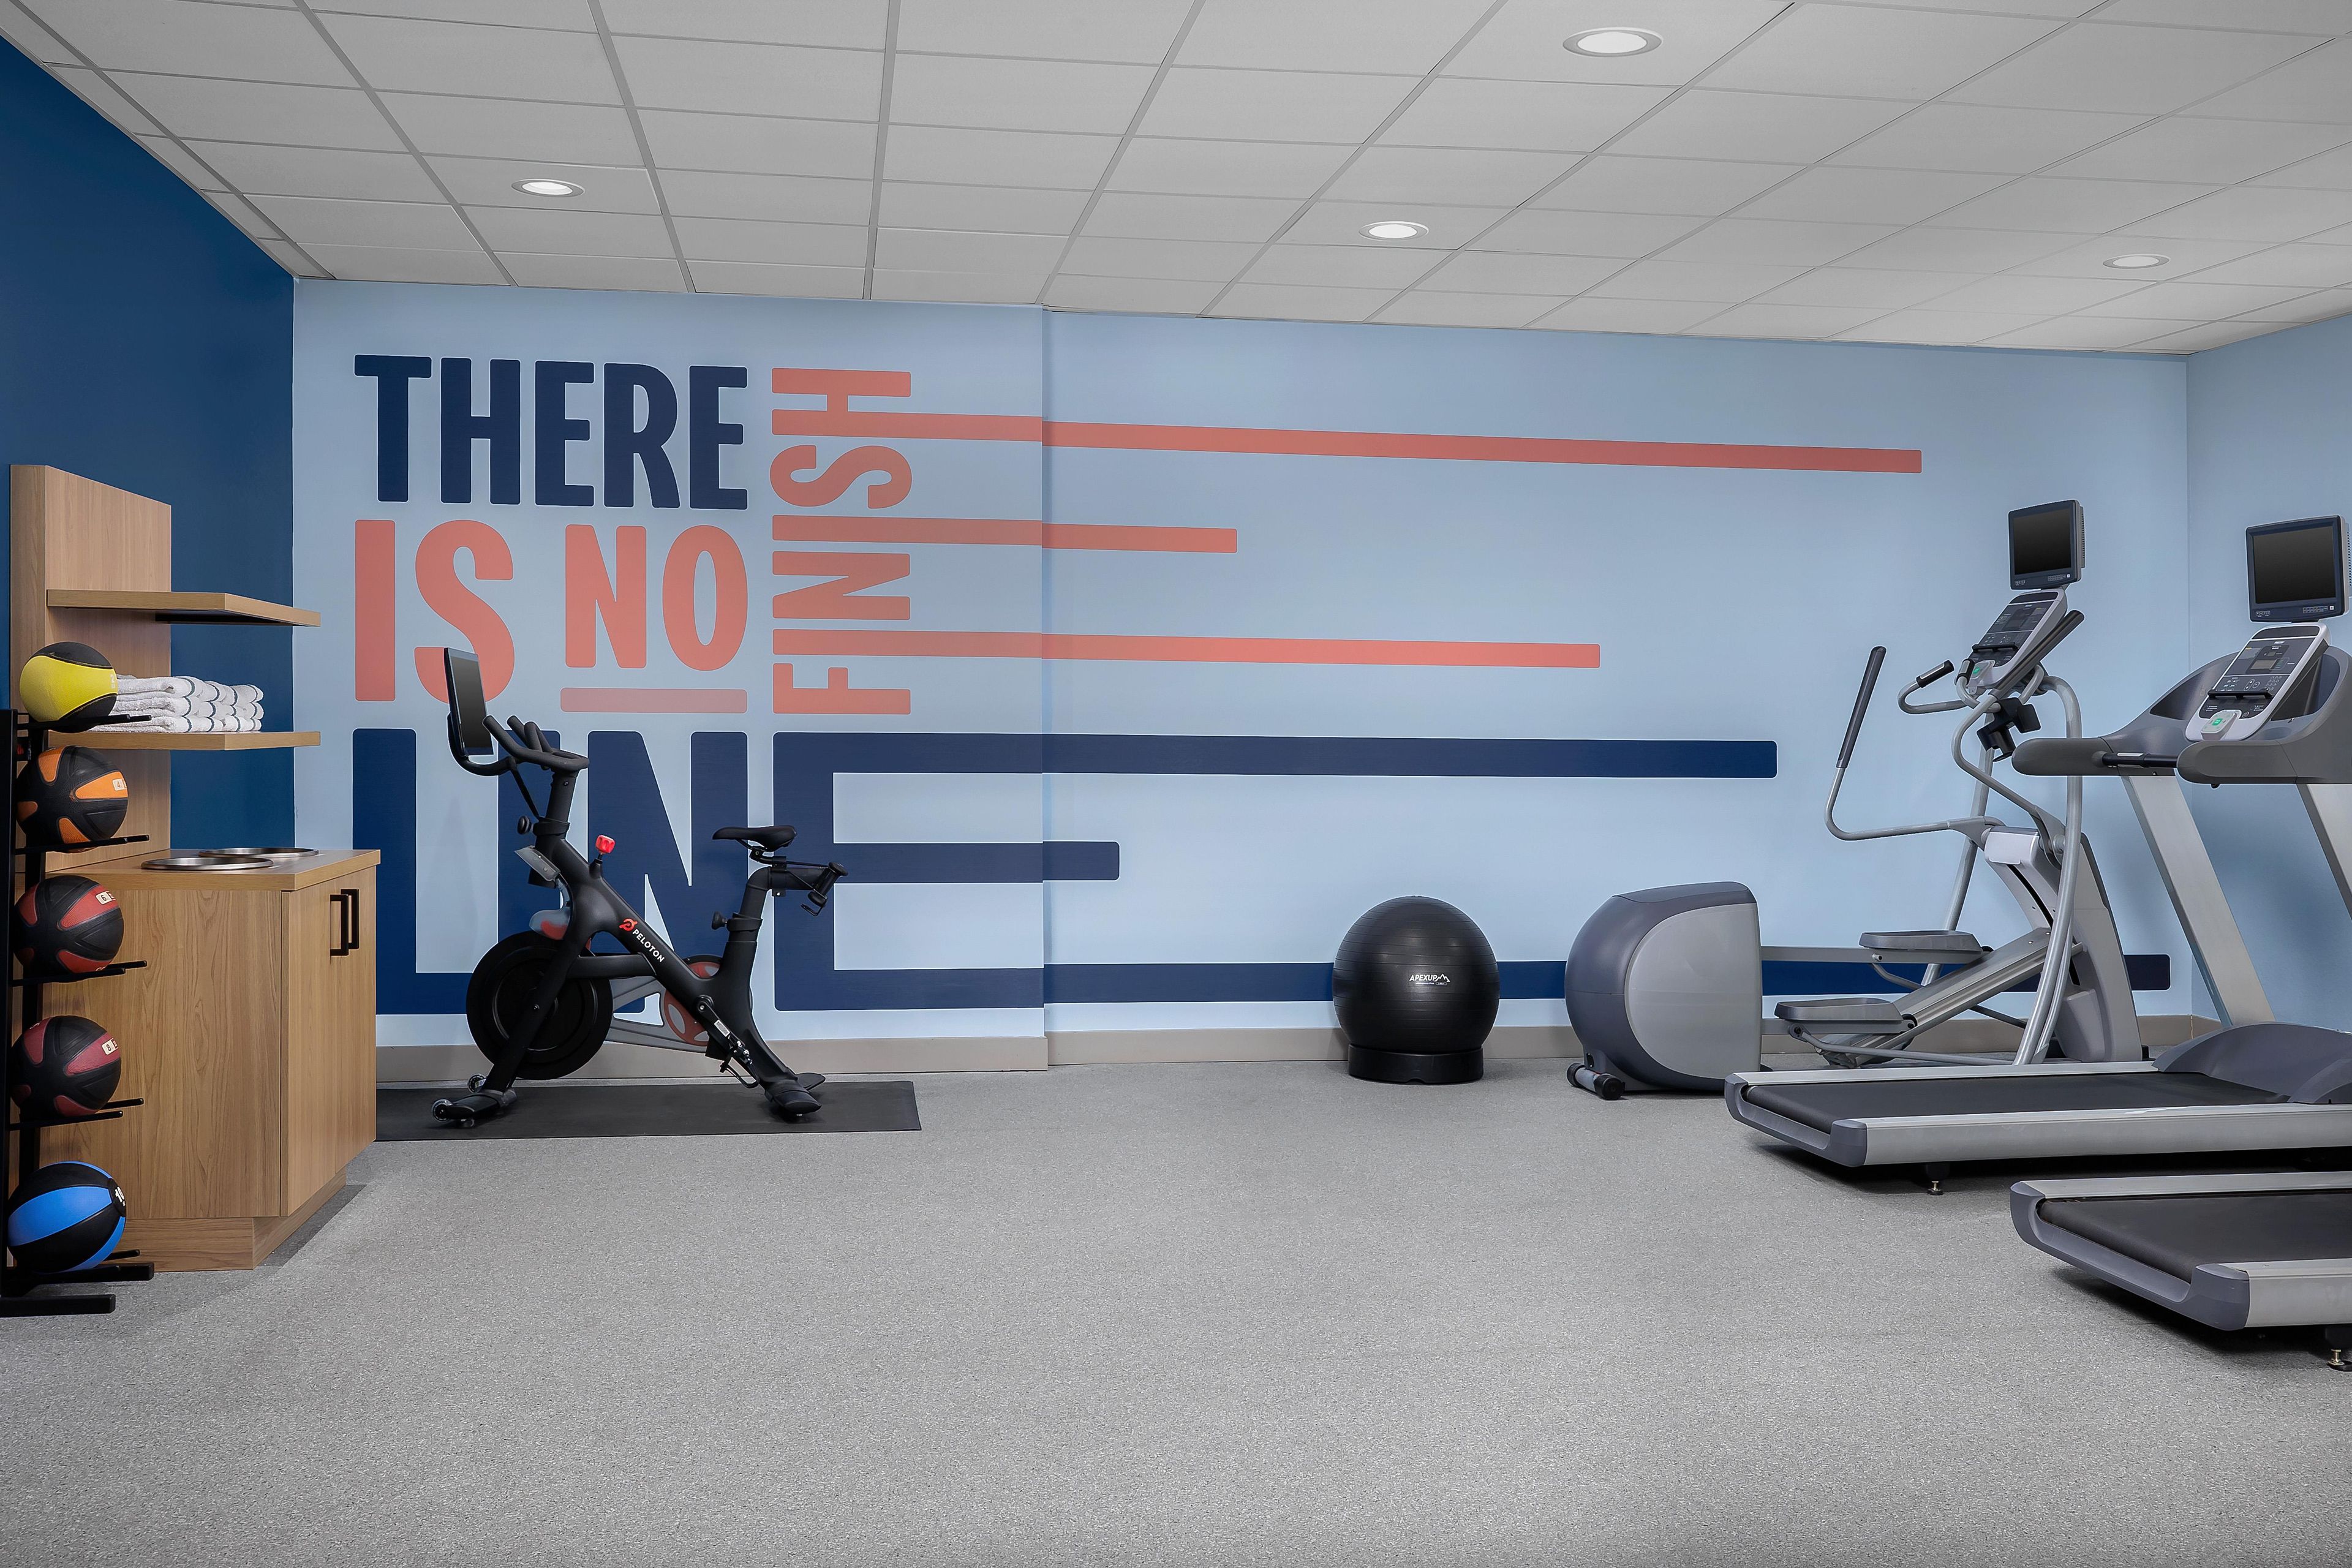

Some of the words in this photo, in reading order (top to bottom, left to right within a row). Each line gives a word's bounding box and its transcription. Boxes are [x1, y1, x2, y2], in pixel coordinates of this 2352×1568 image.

[354, 354, 748, 510] THERE
[355, 519, 515, 704] IS
[565, 524, 748, 671] NO
[770, 368, 912, 715] FINISH
[632, 929, 665, 962] PELOTON
